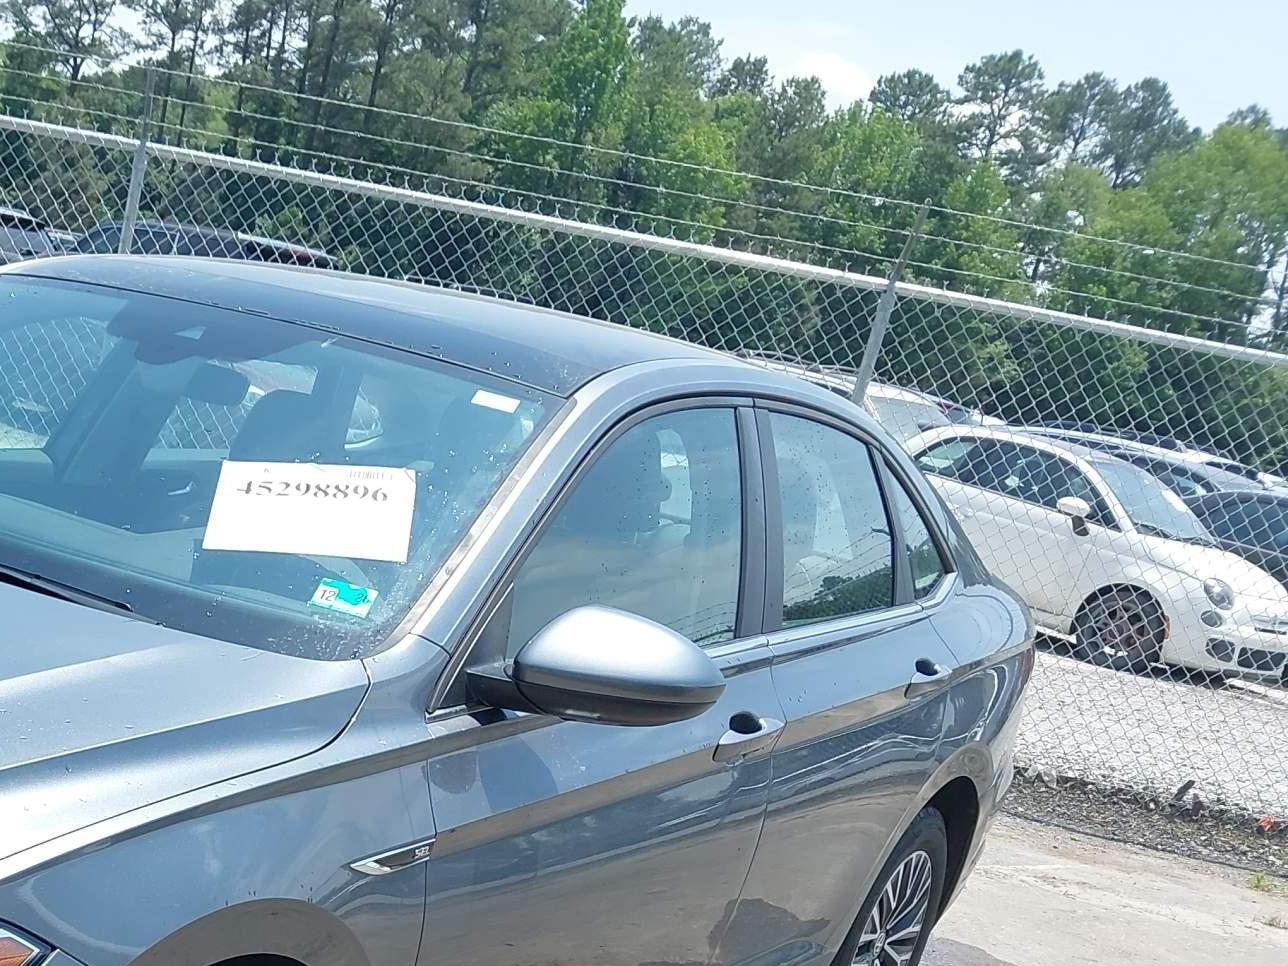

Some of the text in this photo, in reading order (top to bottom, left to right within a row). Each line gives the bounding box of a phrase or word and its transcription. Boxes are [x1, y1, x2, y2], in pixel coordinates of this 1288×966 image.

[236, 480, 389, 502] 45298896
[320, 589, 337, 602] 12
[414, 845, 431, 860] SEL
